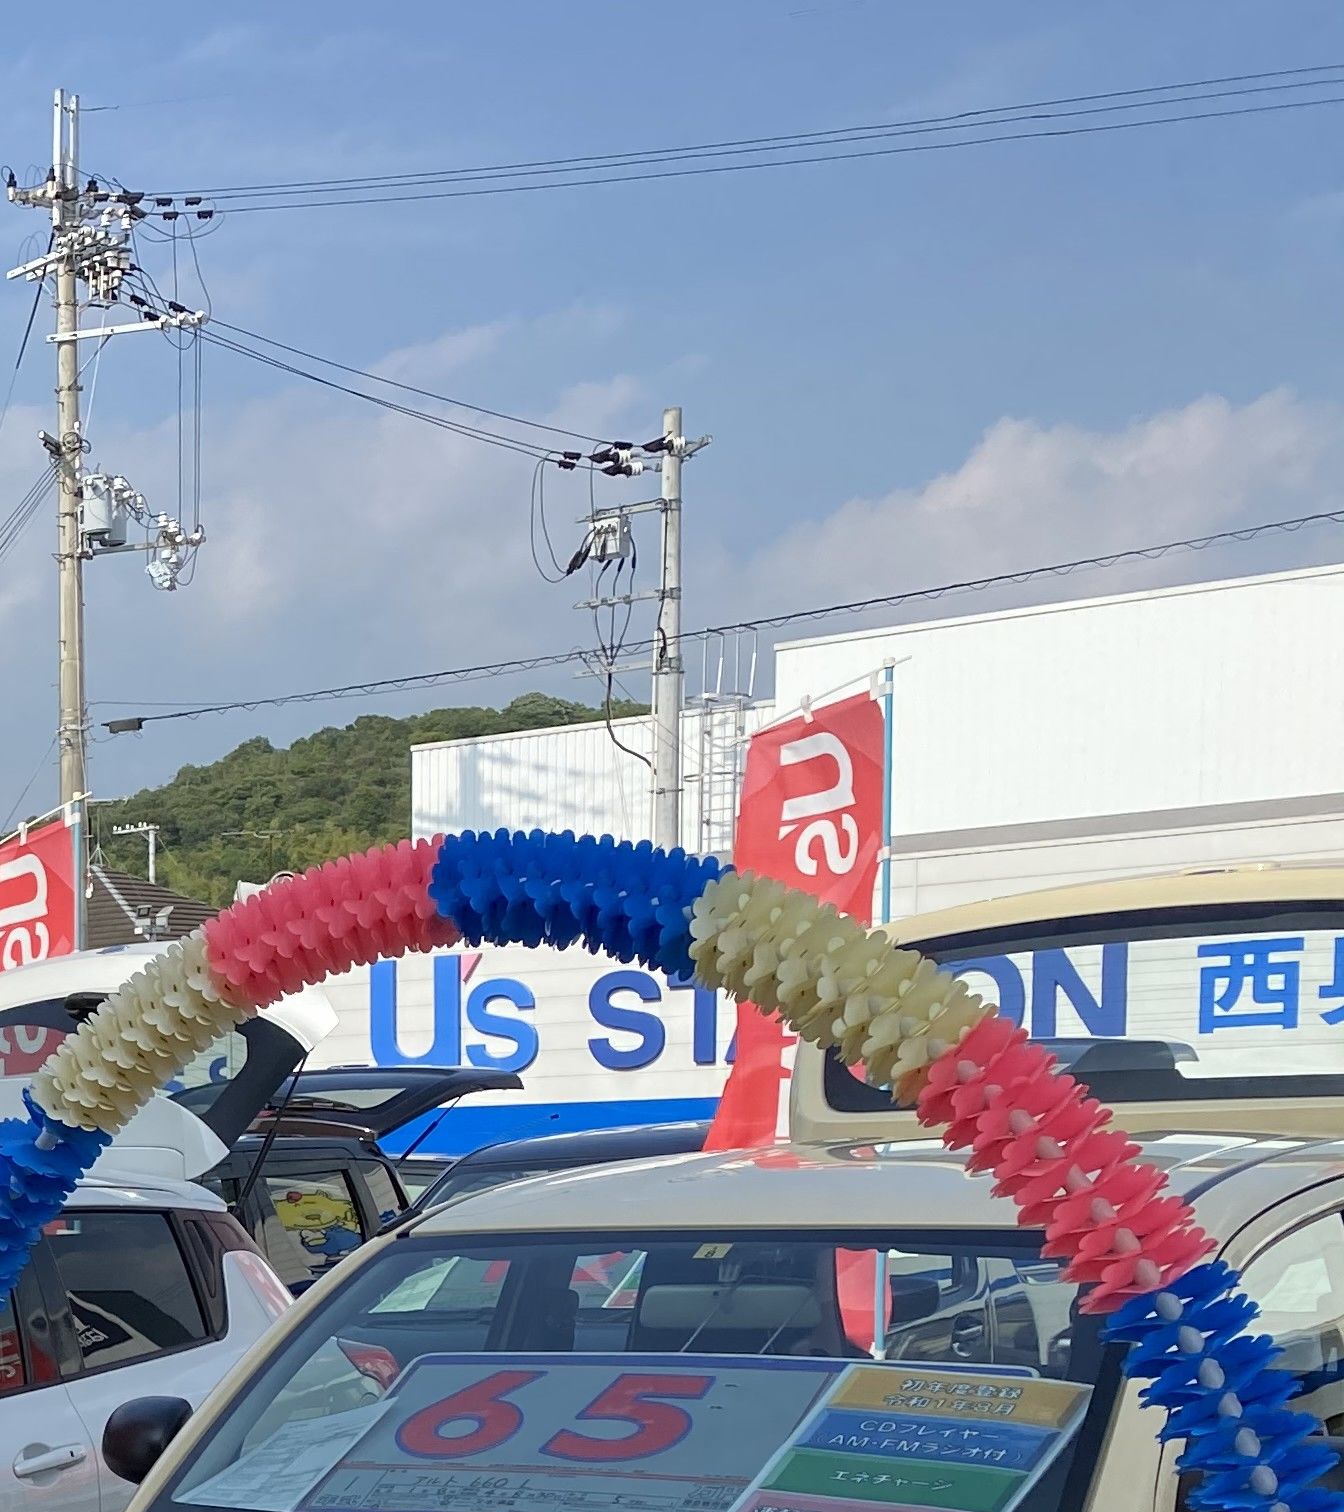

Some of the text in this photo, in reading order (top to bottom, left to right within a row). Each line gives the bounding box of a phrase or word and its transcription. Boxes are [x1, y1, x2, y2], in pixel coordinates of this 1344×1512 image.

[394, 1369, 717, 1463] 65
[830, 1470, 953, 1491] エネチャージ
